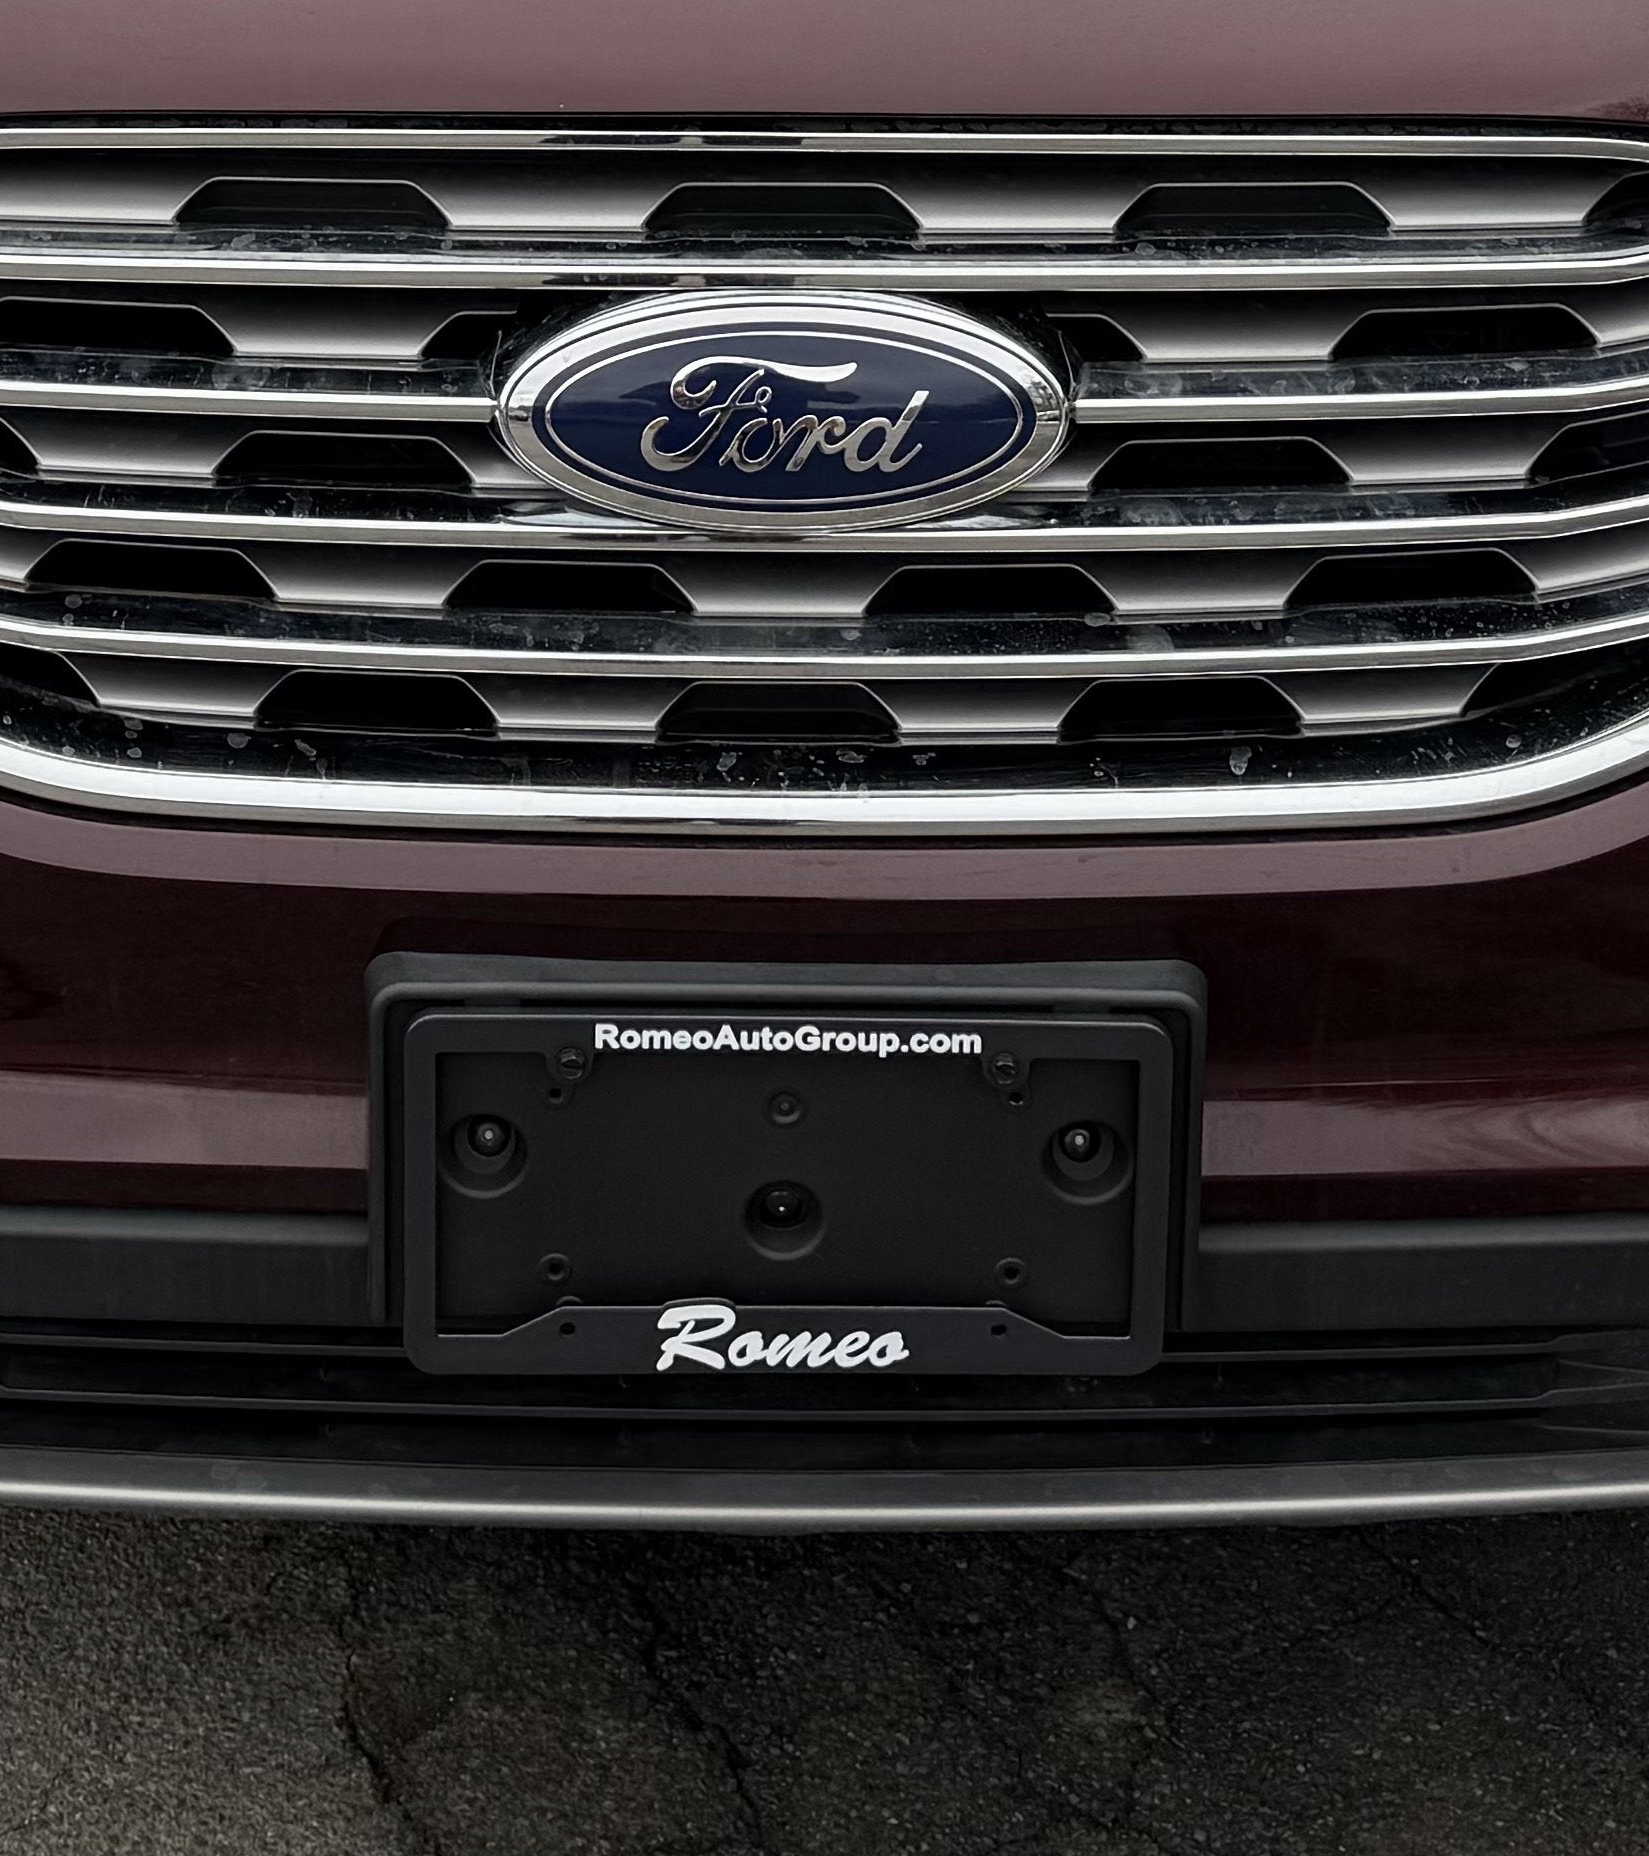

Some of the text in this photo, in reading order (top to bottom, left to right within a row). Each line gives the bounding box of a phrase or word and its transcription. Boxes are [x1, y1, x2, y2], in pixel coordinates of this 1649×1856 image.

[640, 355, 930, 472] Ford
[594, 1023, 982, 1058] RomeoAutoGroup.com
[656, 1305, 910, 1372] Romeo
